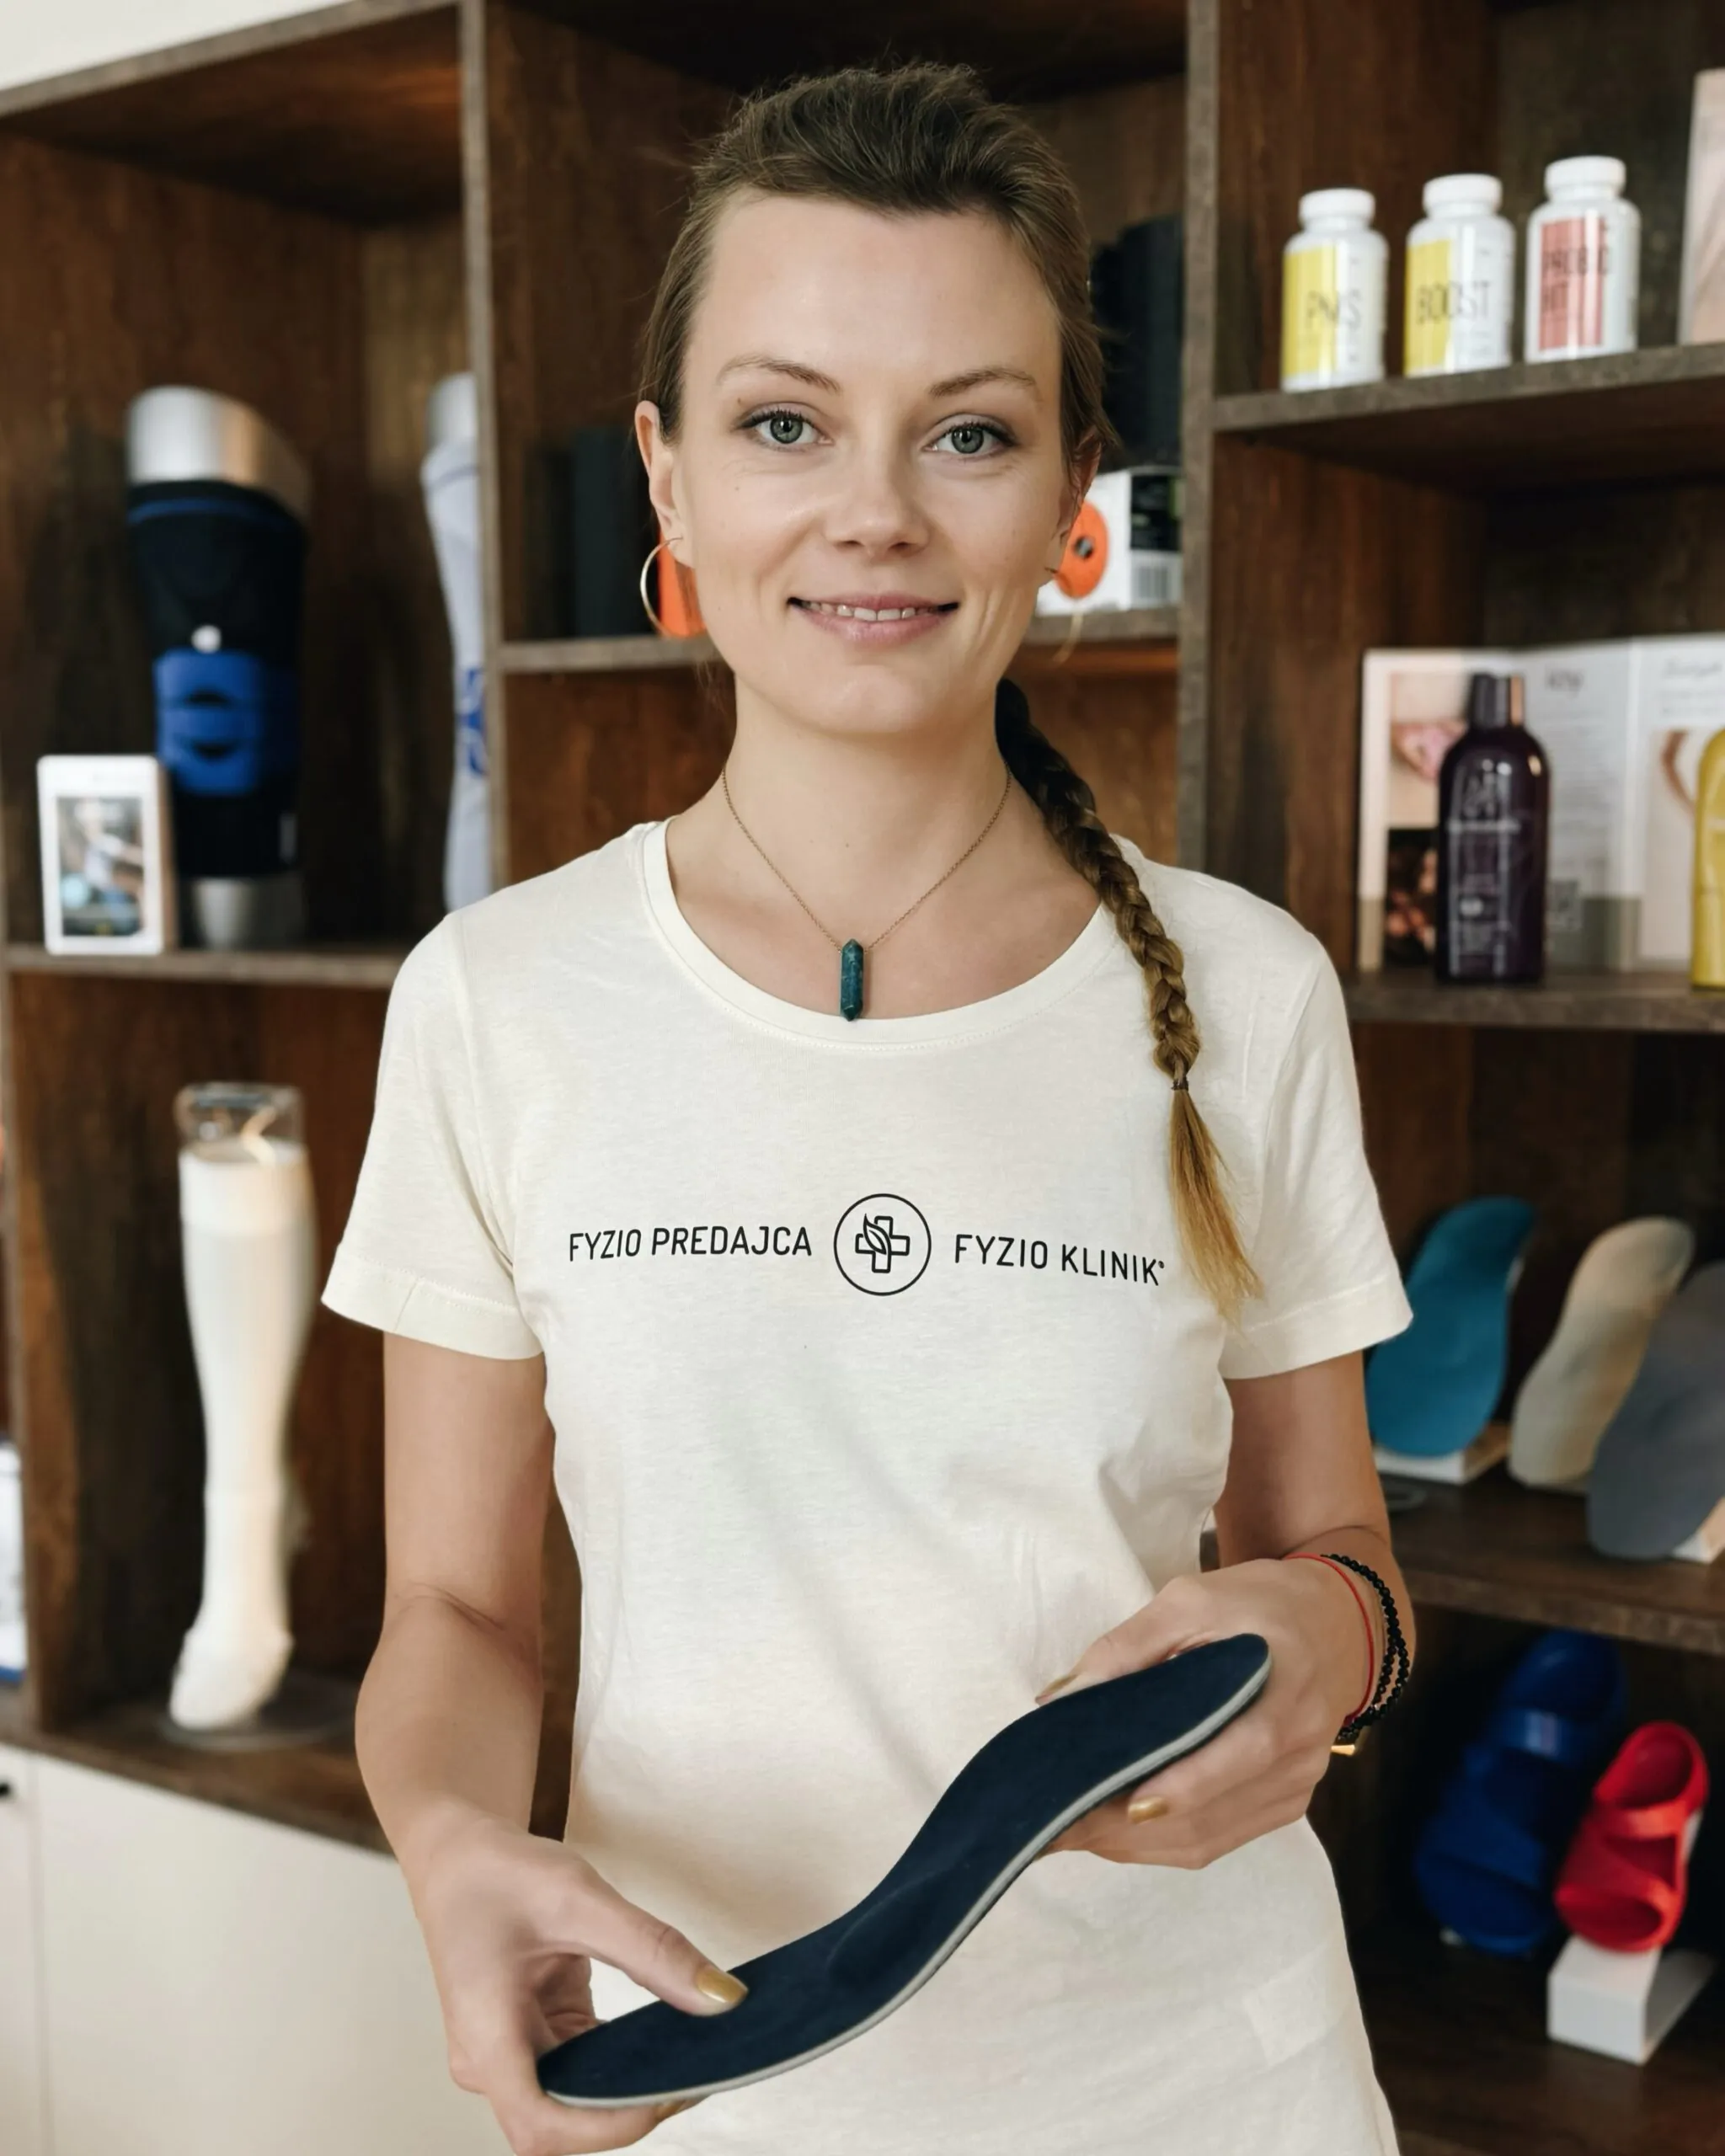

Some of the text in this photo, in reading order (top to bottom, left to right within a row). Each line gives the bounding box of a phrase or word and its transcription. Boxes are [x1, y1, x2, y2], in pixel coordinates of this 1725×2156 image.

[569, 1229, 642, 1262] FYZIO
[651, 1225, 812, 1257] PREDAJCA
[954, 1234, 1048, 1269] FYZIO
